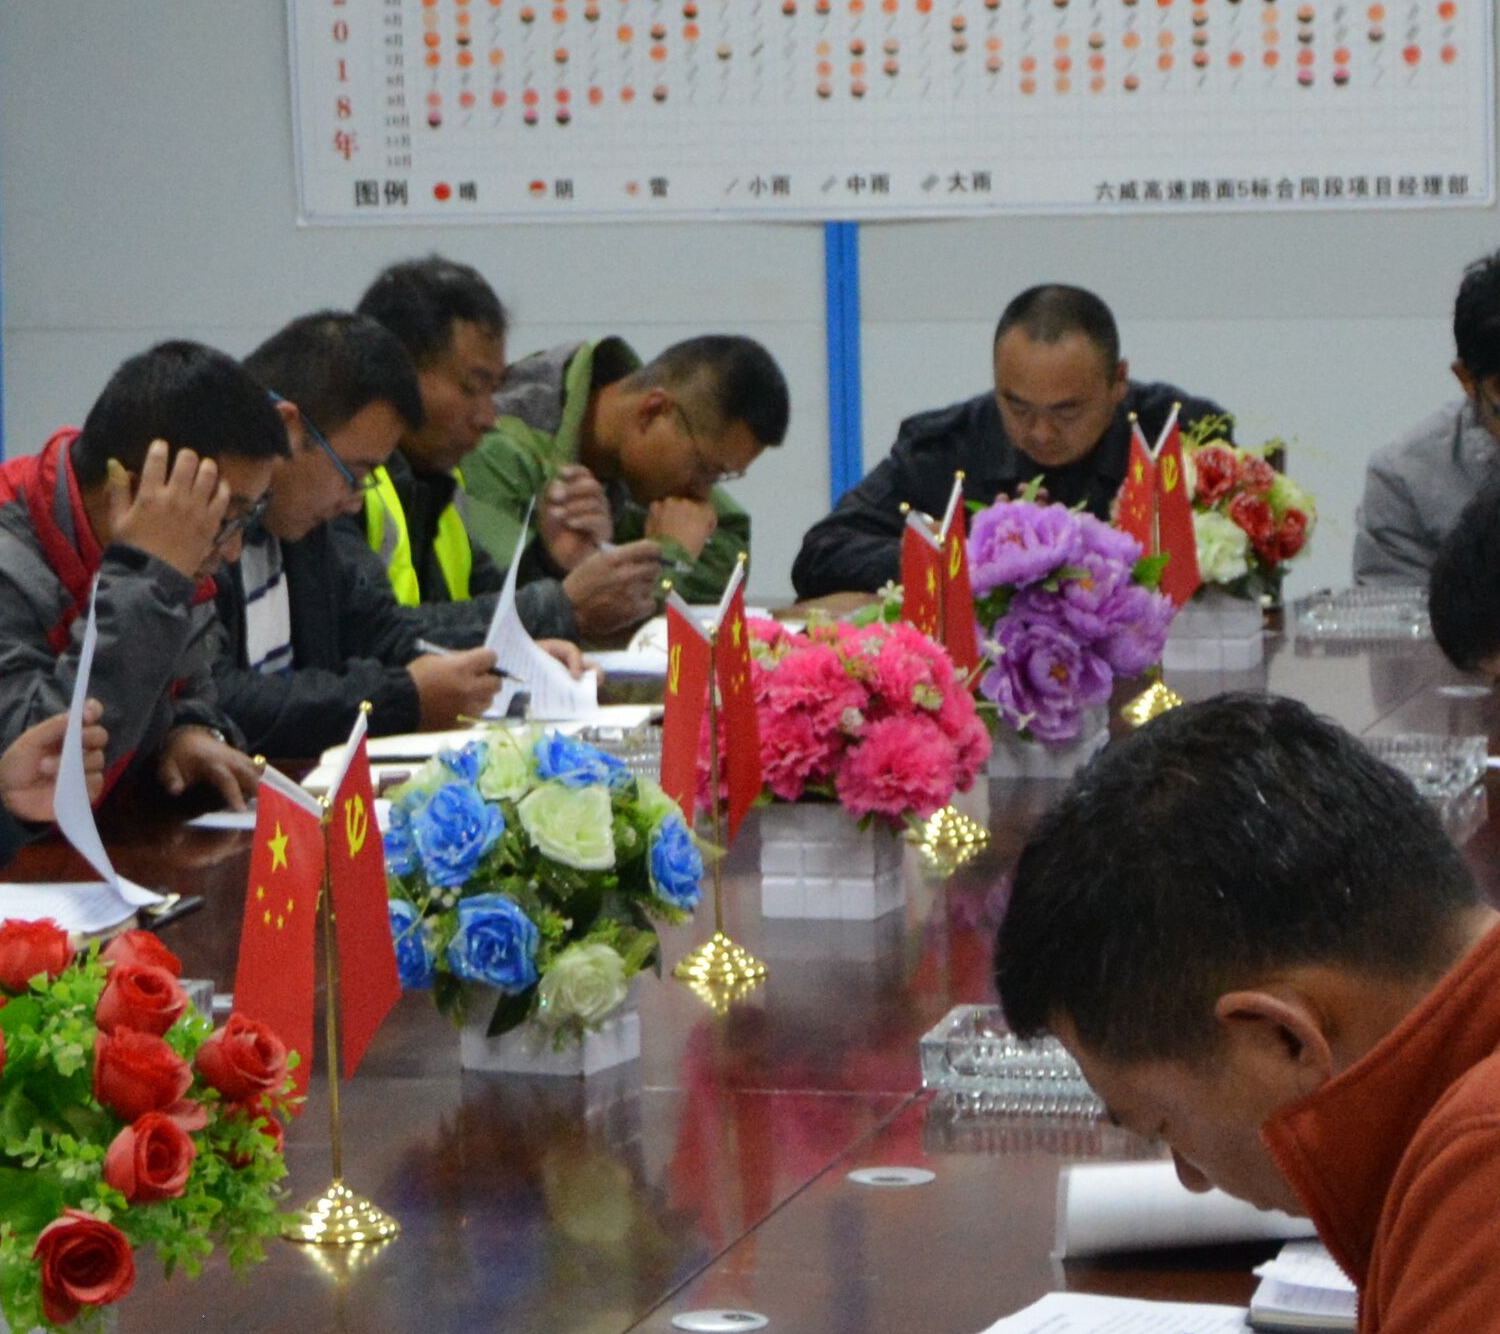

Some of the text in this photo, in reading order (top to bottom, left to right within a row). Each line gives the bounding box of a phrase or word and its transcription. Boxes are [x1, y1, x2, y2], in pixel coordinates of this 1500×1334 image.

[355, 180, 408, 207] 图例
[749, 174, 791, 198] 小雨
[847, 173, 891, 195] 中雨
[949, 170, 992, 194] 大雨
[1096, 174, 1470, 202] 六威高速路面5标合同段项目经理部
